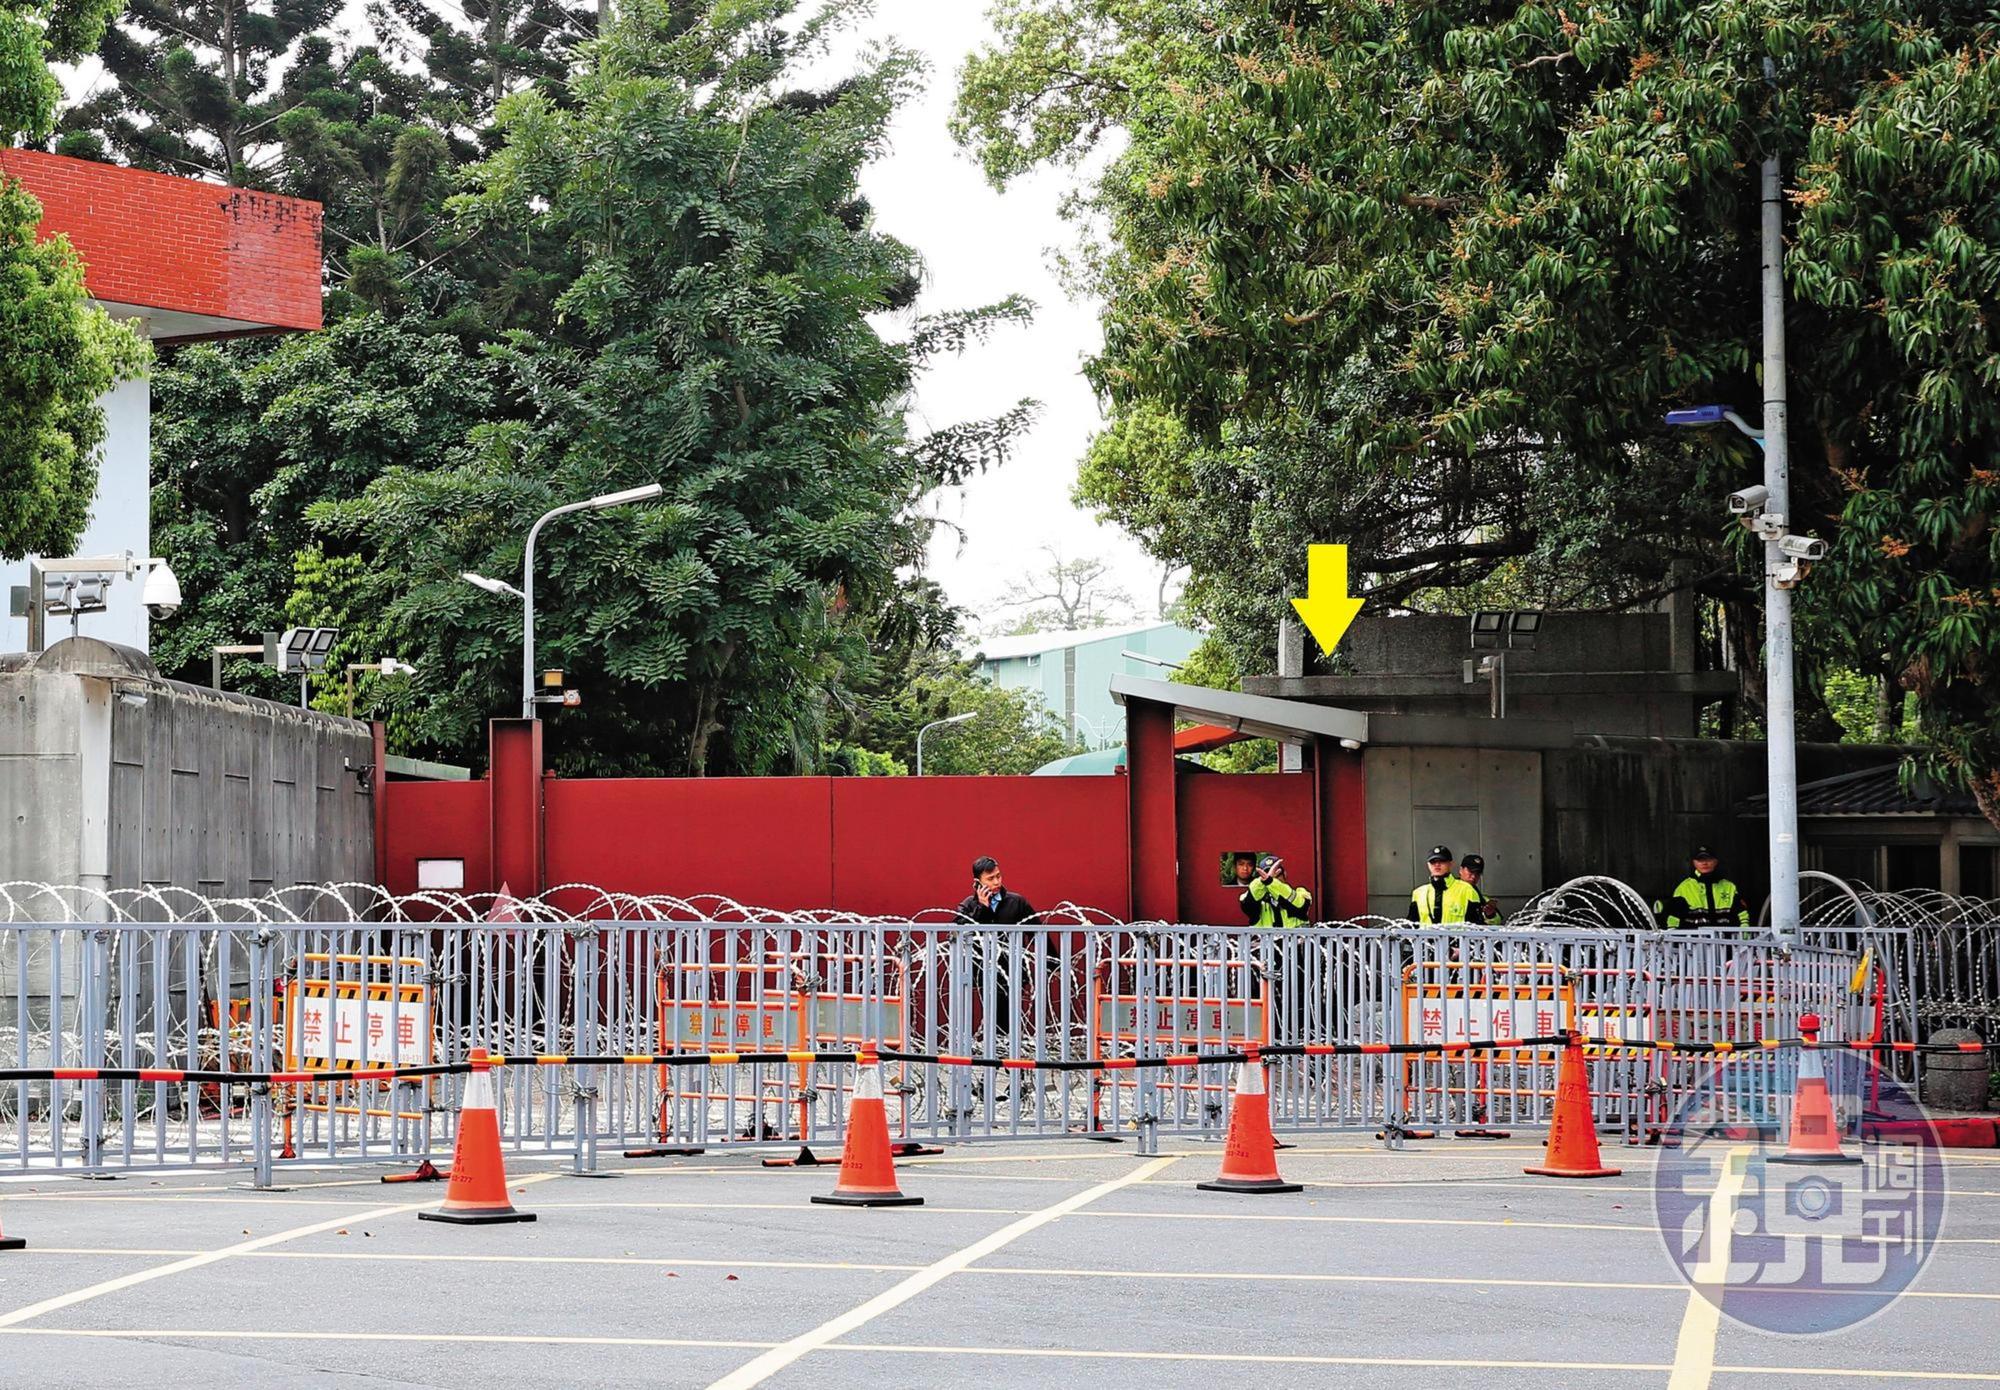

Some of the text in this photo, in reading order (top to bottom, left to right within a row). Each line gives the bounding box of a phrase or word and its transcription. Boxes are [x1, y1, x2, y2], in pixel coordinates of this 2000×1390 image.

[303, 1008, 415, 1049] 禁止停車
[688, 1012, 774, 1038] 禁止停車
[1422, 1008, 1555, 1038] 禁止停車
